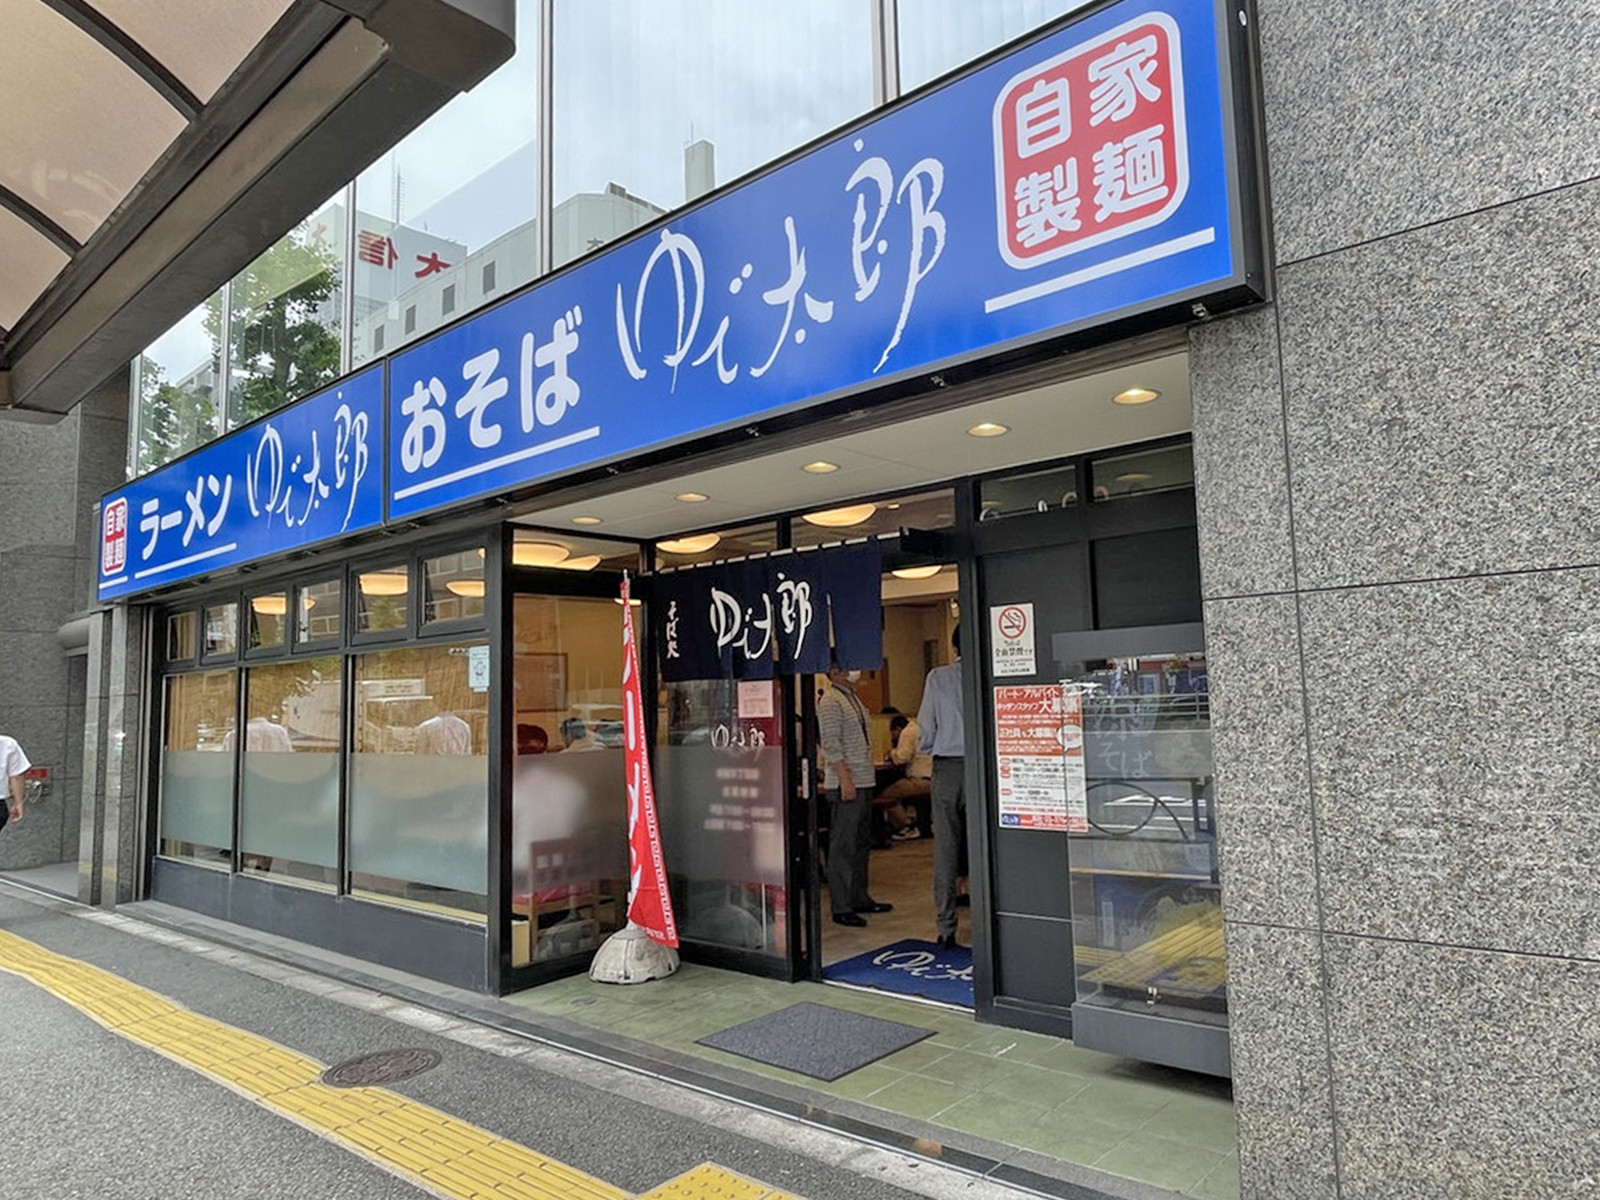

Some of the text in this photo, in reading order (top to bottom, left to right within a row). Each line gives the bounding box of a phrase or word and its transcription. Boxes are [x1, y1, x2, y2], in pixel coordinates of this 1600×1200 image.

[616, 138, 946, 393] ゆで太郎
[246, 391, 369, 533] ゆで太郎
[400, 304, 584, 474] おそば
[140, 474, 232, 560] ラーメン
